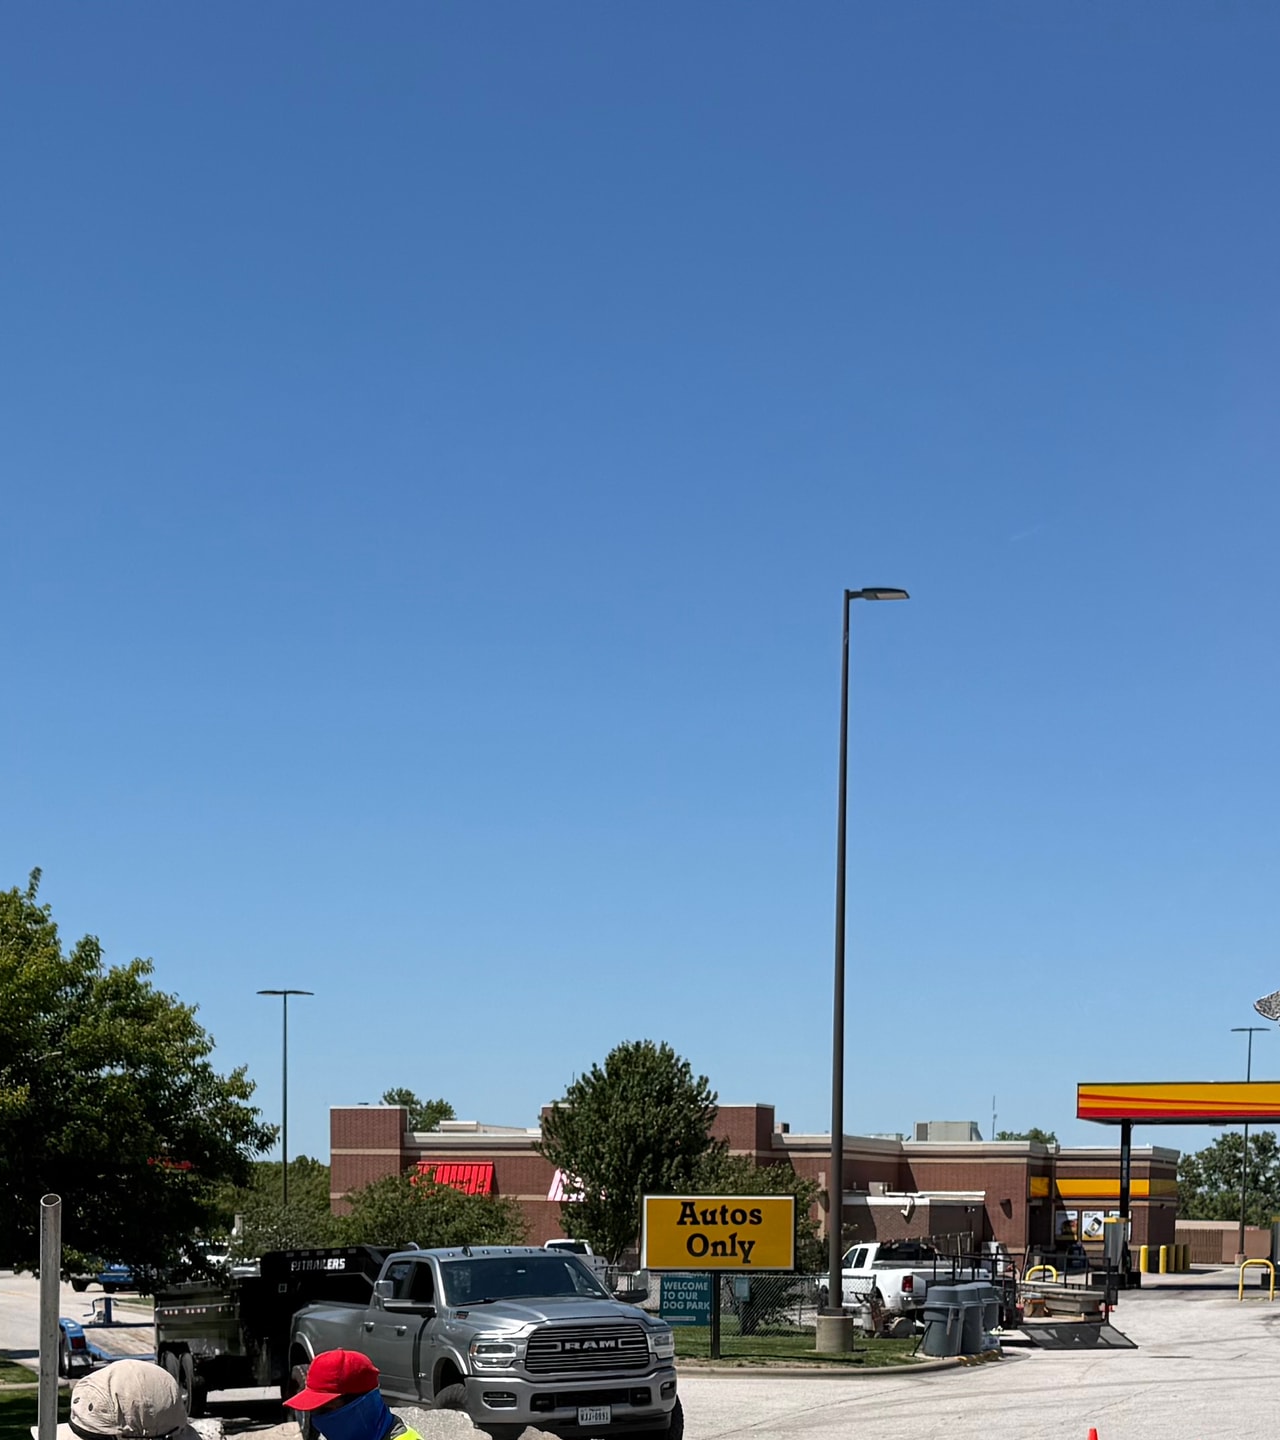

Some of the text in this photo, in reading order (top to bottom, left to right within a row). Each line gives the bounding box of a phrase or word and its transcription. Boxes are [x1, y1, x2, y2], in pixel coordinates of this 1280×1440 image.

[677, 1201, 763, 1226] Autos
[686, 1231, 756, 1264] Only
[302, 1258, 346, 1270] TRAILERS
[663, 1281, 709, 1291] WELCOME
[663, 1291, 698, 1300] TO OUR
[663, 1301, 711, 1310] DOG PARK
[564, 1340, 616, 1350] RAM
